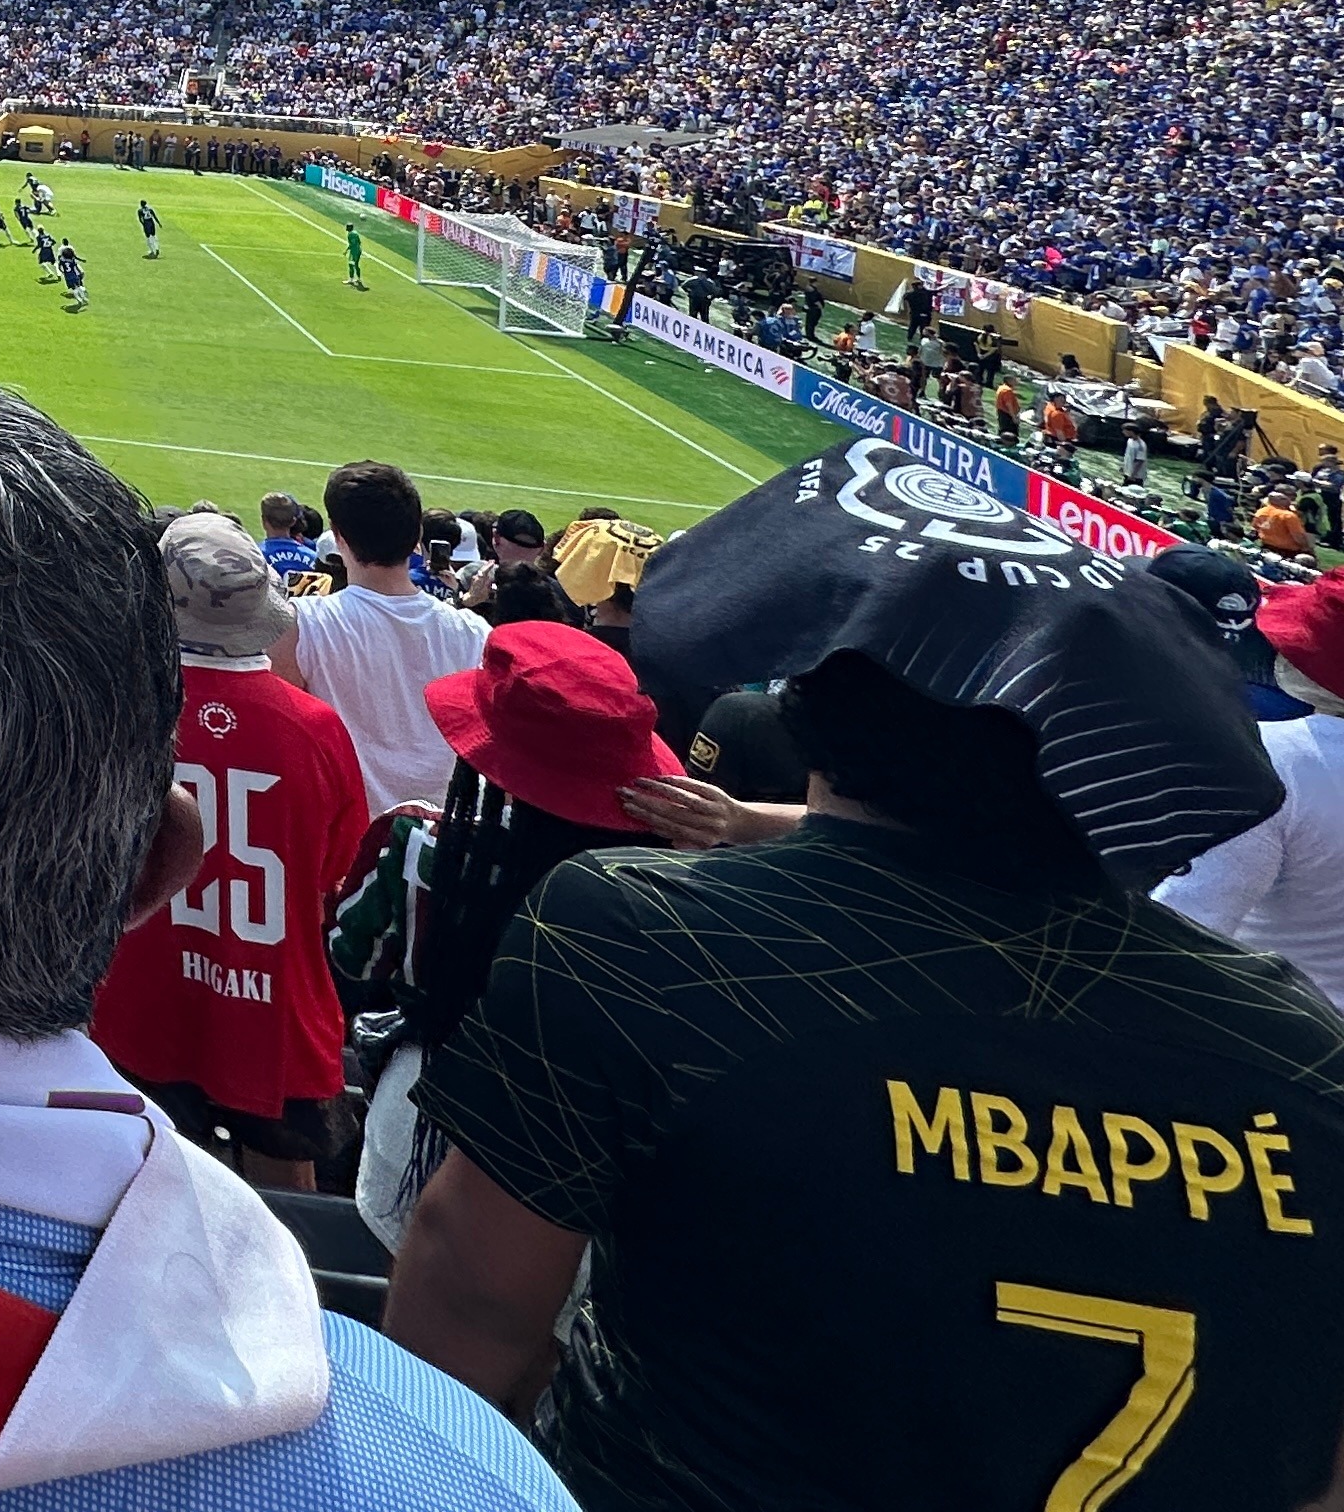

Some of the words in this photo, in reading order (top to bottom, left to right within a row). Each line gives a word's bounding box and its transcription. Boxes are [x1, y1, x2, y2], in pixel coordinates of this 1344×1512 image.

[321, 167, 366, 199] Hisense
[633, 299, 670, 334] BANK
[671, 317, 694, 343] OF
[696, 327, 766, 379] AMERICA
[809, 379, 888, 435] Michelob
[908, 422, 994, 492] ULTRA
[794, 458, 823, 504] FIFA
[957, 556, 1071, 589] CUP
[182, 950, 273, 1005] HIGAKI
[885, 1078, 1314, 1236] MBAPPÉ
[995, 1281, 1197, 1512] 7
